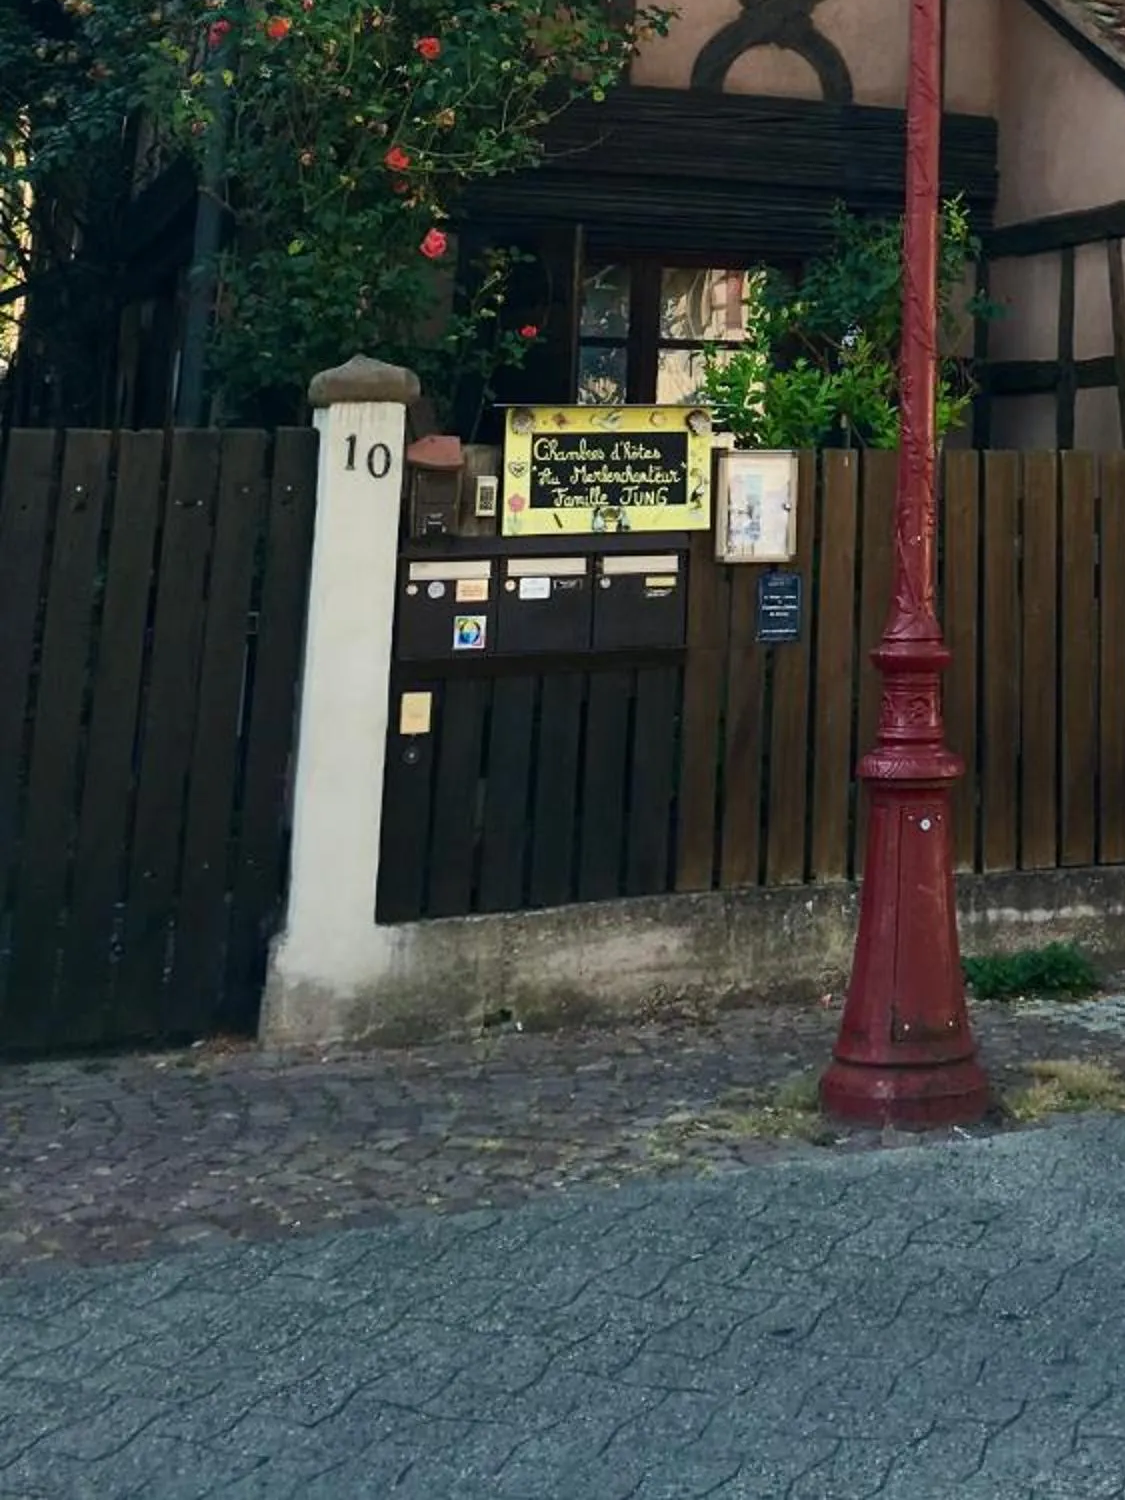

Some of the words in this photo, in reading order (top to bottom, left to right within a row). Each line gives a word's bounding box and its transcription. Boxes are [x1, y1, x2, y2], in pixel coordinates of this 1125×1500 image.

[344, 433, 392, 479] 10
[533, 437, 605, 461] Chambres
[610, 440, 662, 460] d'hôtes
[551, 485, 610, 507] Famille
[619, 485, 669, 506] JUNG
